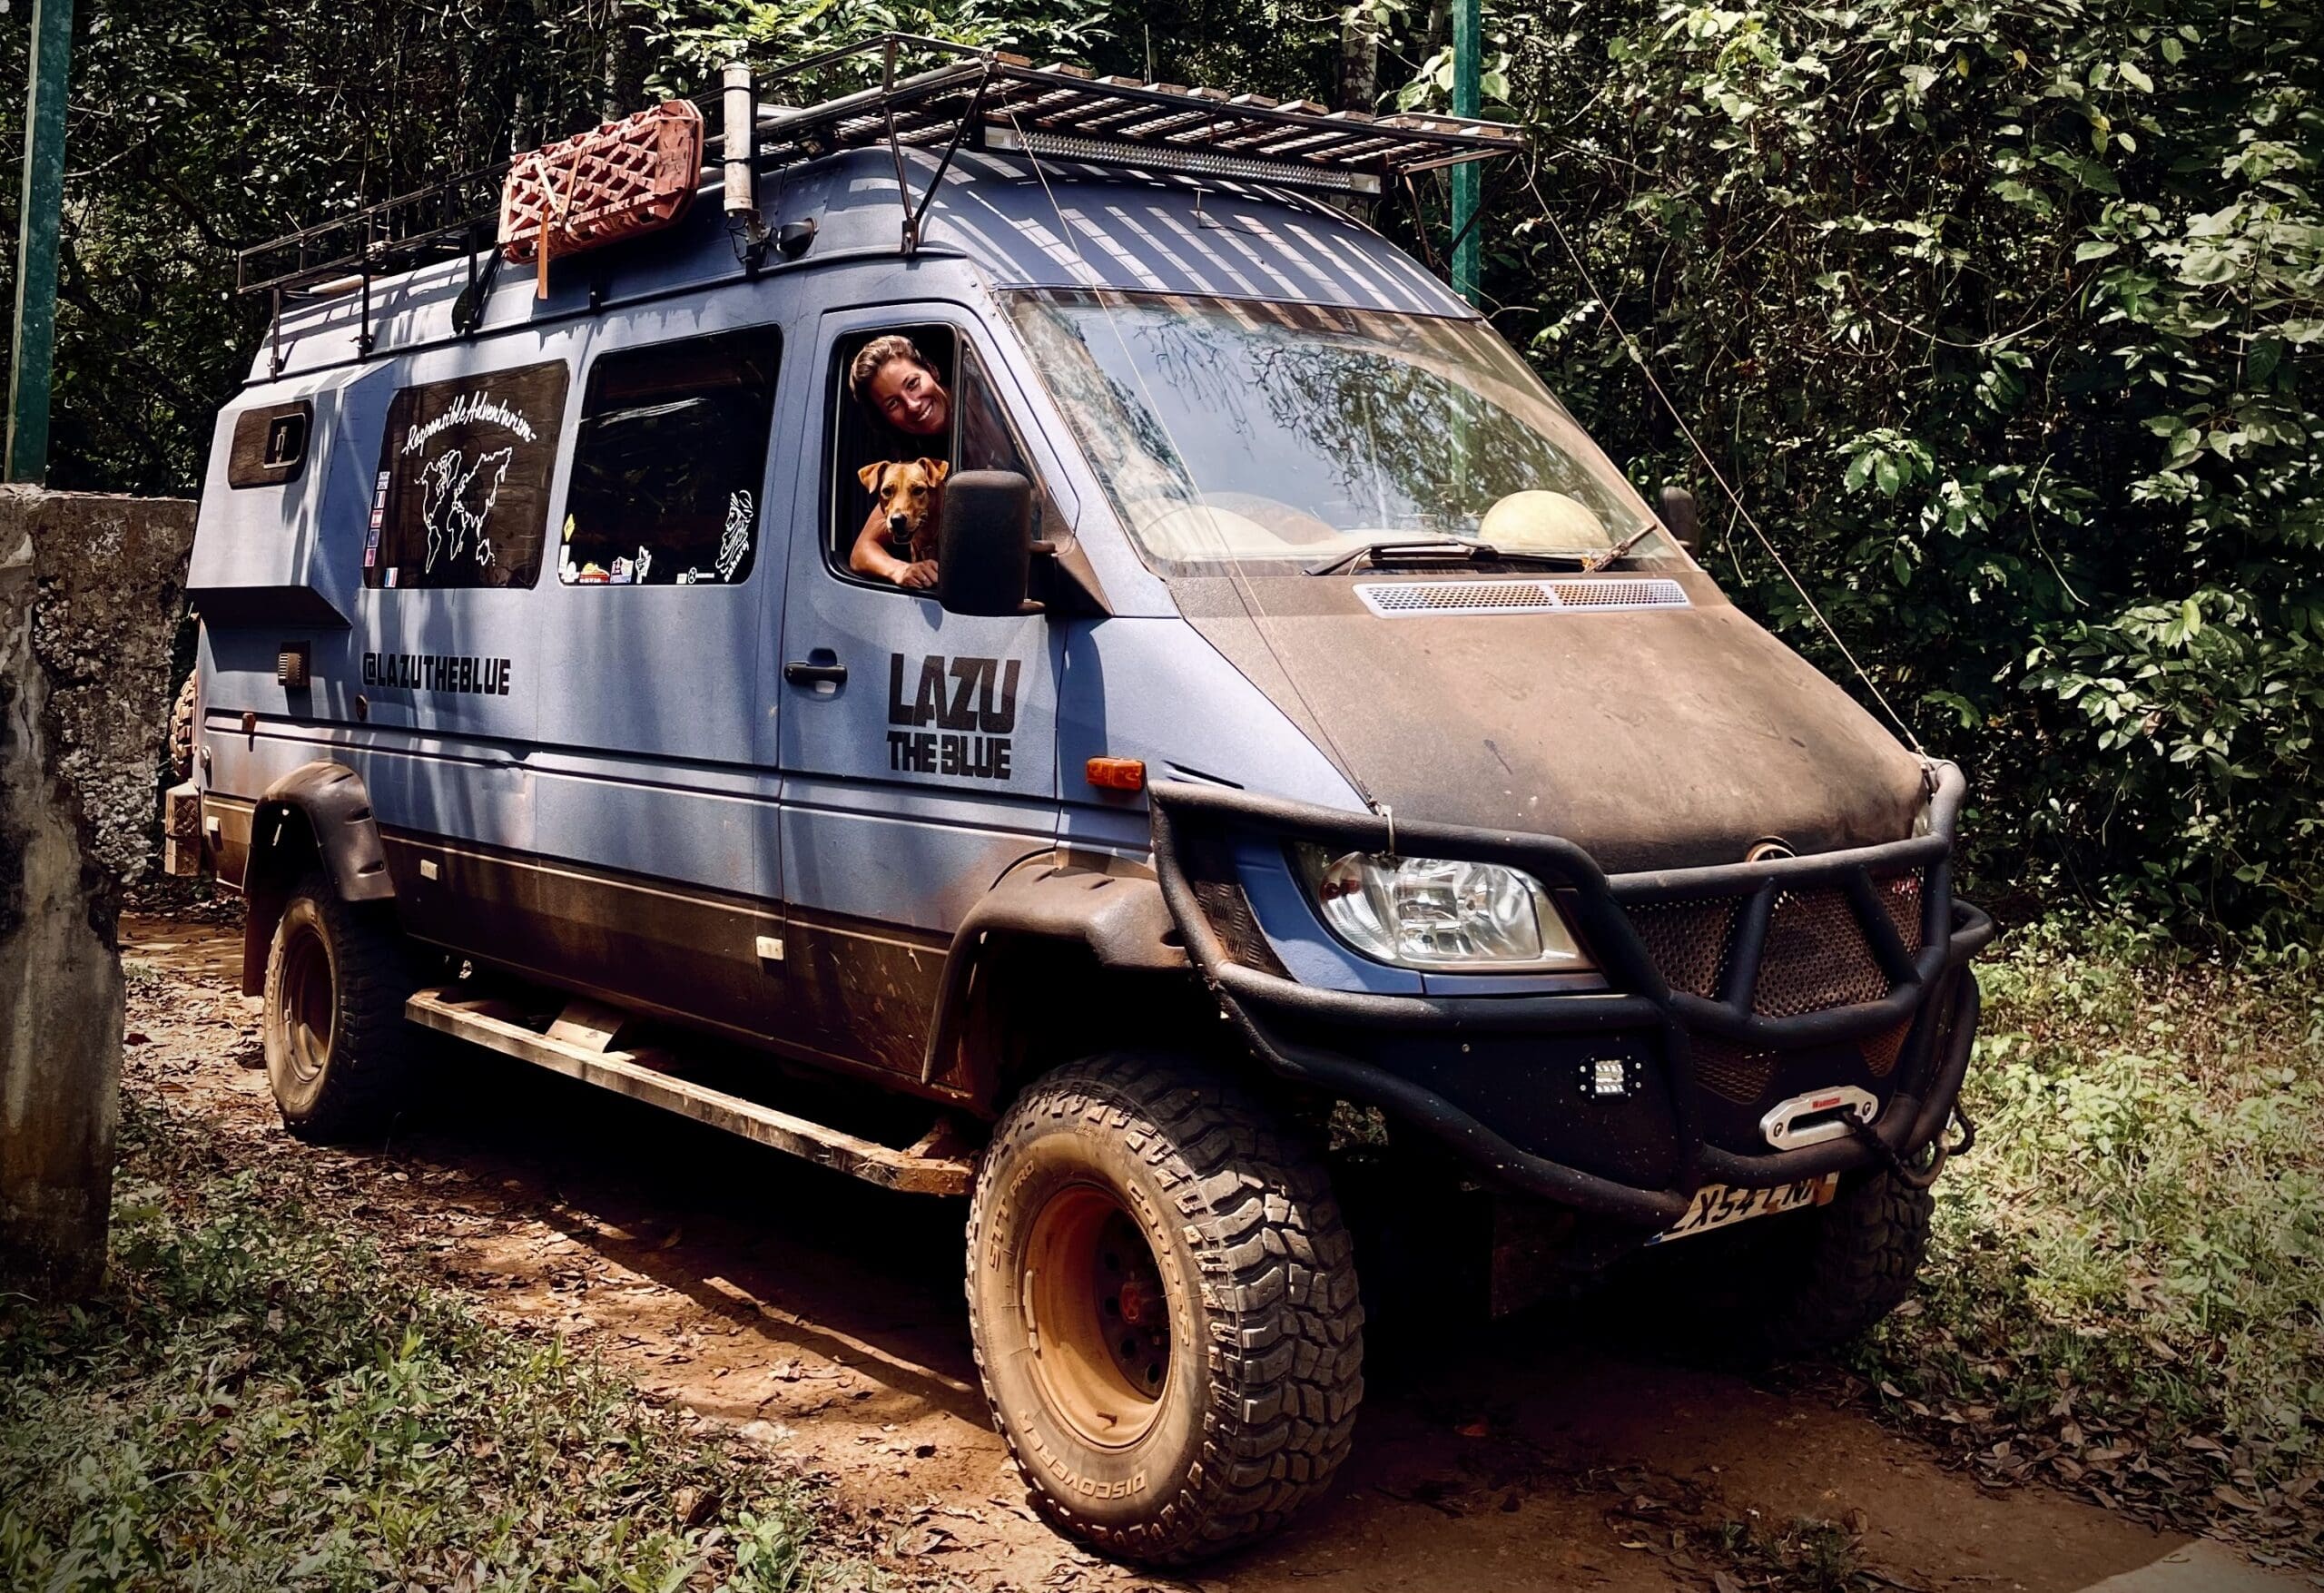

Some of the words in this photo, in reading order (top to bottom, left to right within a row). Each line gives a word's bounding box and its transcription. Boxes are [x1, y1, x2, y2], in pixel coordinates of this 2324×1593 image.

[363, 652, 511, 696] @LAZUTHEBLUE
[889, 653, 1021, 734] LAZU
[886, 730, 938, 774] THE
[988, 1195, 1009, 1273] STT
[1009, 1159, 1035, 1198] PRO
[1018, 1408, 1148, 1500] DISCOVERER
